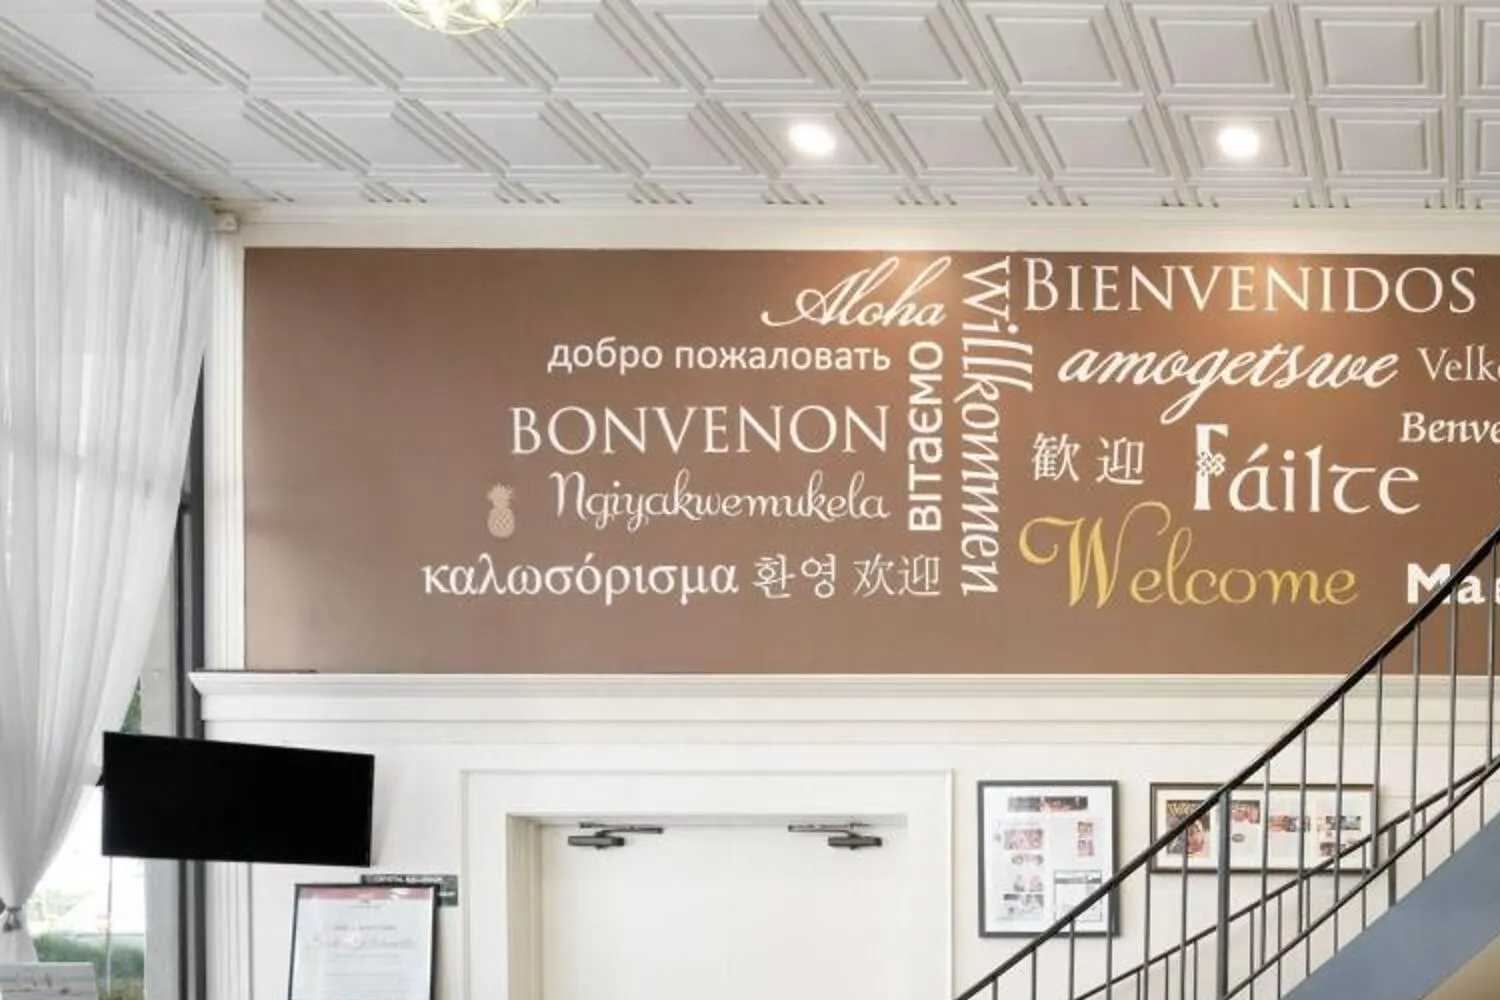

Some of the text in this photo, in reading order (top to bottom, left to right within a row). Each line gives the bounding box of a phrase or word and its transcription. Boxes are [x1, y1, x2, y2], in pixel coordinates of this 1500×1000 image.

[761, 256, 952, 327] Aloha
[1024, 257, 1476, 313] BIENVENIDOS
[547, 336, 891, 376] добро пожаловать
[1057, 342, 1399, 425] amogetswe
[511, 404, 891, 455] BONVENON
[953, 255, 1034, 597] Willkommen
[549, 468, 891, 533] Ngiyakwemukela
[421, 552, 739, 606] καλωσόρισμα
[751, 553, 837, 599] 환영
[852, 553, 942, 597] 欢迎
[1018, 500, 1360, 609] Welcome
